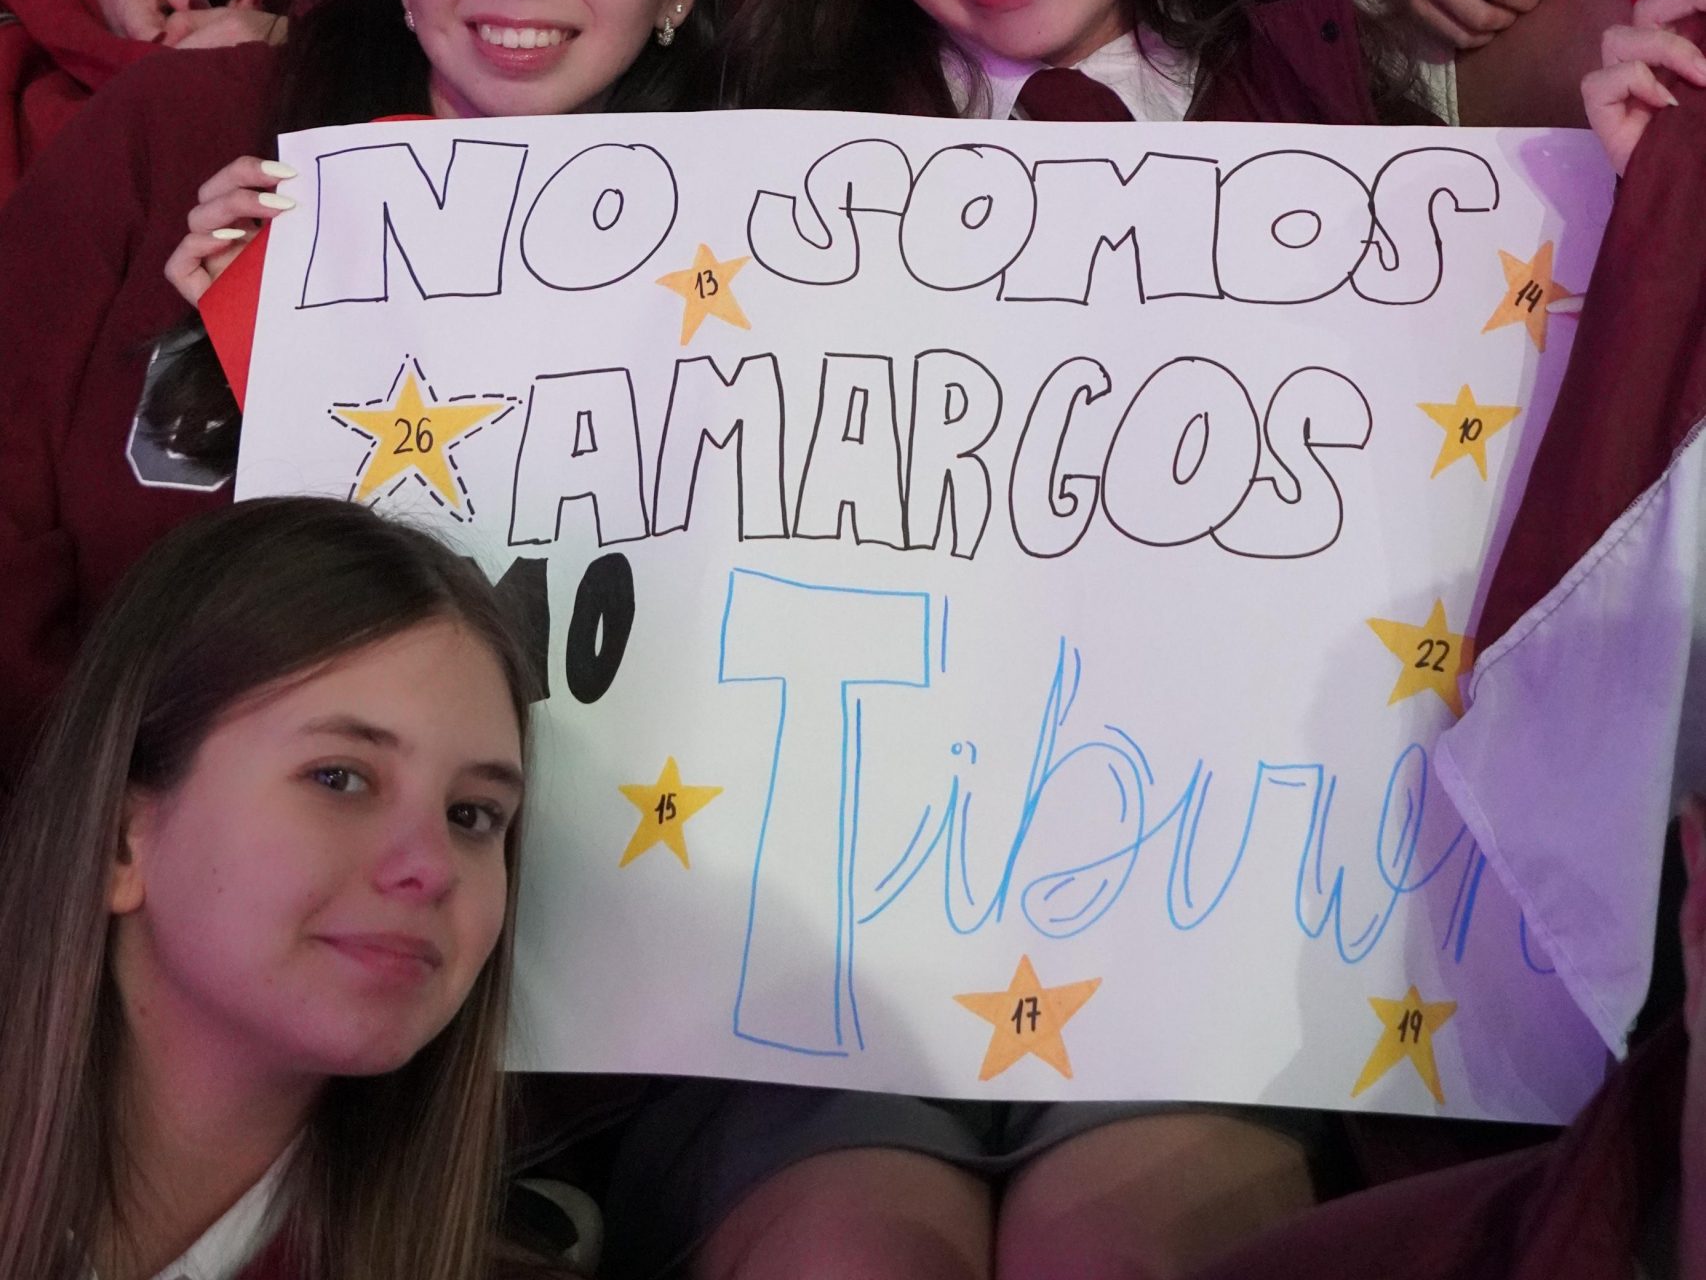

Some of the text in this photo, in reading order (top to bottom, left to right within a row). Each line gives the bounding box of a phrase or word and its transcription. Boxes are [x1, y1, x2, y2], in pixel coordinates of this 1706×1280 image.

[296, 138, 1500, 309] NO SOMOS
[693, 269, 720, 299] 13
[1513, 280, 1543, 313] 14
[392, 417, 435, 454] 26
[1457, 417, 1483, 443] 10
[508, 348, 1373, 560] AMARGOS
[1414, 639, 1450, 673] 22
[654, 792, 677, 824] 15
[1010, 996, 1042, 1035] 17
[1398, 1009, 1424, 1044] 19
